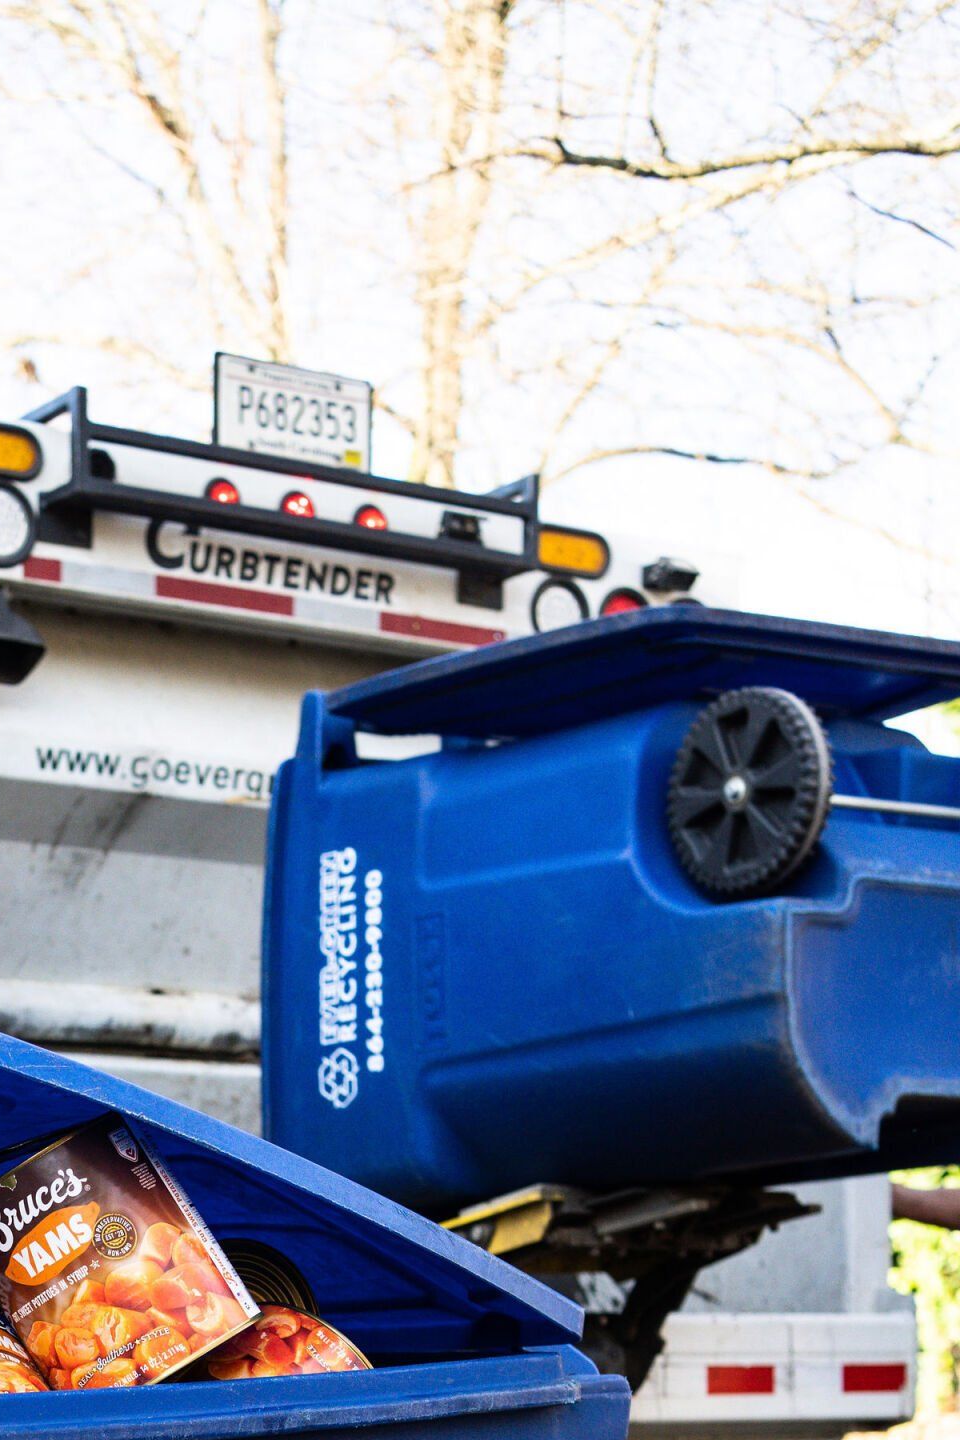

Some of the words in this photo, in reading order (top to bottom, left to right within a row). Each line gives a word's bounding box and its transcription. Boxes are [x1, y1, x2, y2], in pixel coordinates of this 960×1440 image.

[238, 385, 357, 443] P682353
[144, 517, 395, 603] CURBTENDER
[338, 847, 357, 1042] RECYCLING
[13, 1213, 92, 1278] YAMS
[95, 1215, 133, 1233] PRESERVATIVES
[17, 1302, 34, 1319] SWEET
[31, 1285, 61, 1309] POTATOES
[57, 1279, 69, 1291] IN
[67, 1265, 90, 1285] SYRUP
[78, 1371, 94, 1388] REAL
[96, 1341, 135, 1372] Southern
[140, 1327, 171, 1343] STYLE
